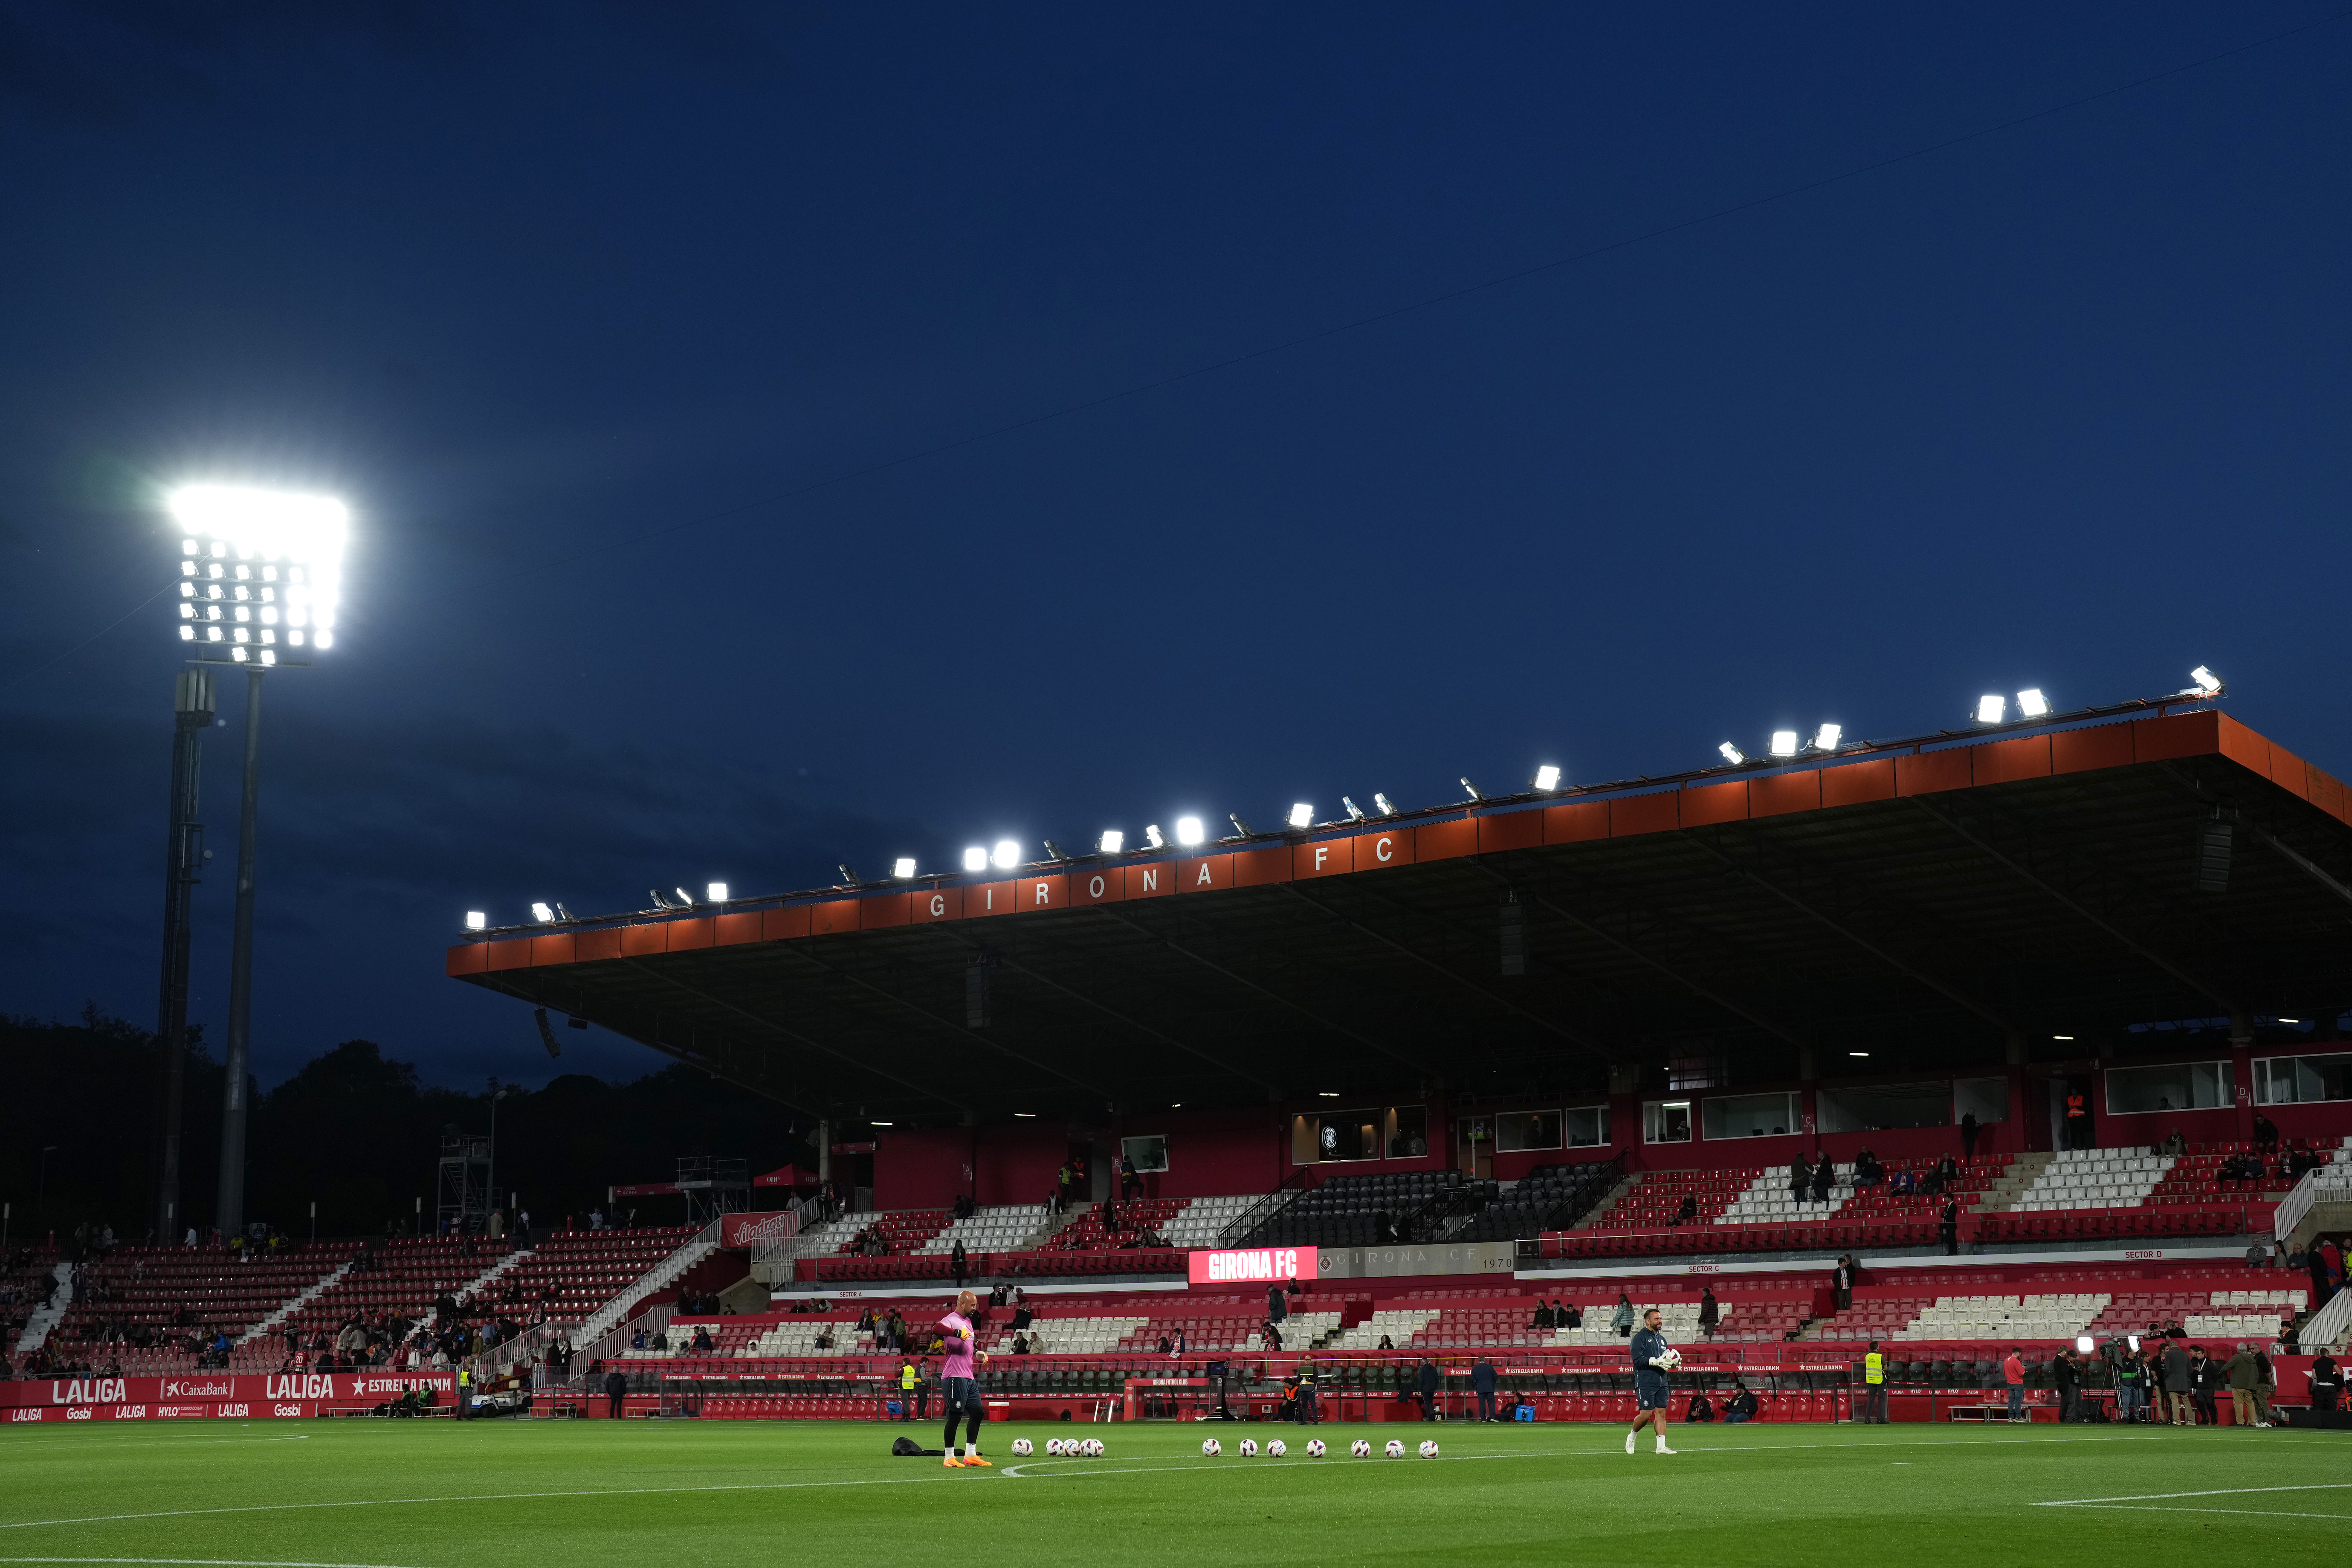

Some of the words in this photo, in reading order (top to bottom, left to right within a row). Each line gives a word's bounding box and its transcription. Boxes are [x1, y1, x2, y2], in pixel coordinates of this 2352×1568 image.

[930, 862, 1212, 916] GIRONA
[1316, 838, 1392, 871] FC
[2240, 1087, 2246, 1096] D
[1337, 1250, 1426, 1264] GIRONA
[1483, 1258, 1512, 1268] 1970
[1208, 1251, 1272, 1280] GIRONA
[1278, 1250, 1297, 1278] FC
[53, 1379, 126, 1403] LALIGA
[181, 1382, 228, 1396] CaixaBank
[266, 1374, 333, 1399] LALIGA
[12, 1408, 42, 1421] LALIGA
[67, 1407, 92, 1420] Gosbi
[116, 1405, 145, 1418] LALIGA
[158, 1407, 178, 1417] HYLO
[218, 1404, 249, 1417] LALIGA
[274, 1403, 301, 1416] Gosbi
